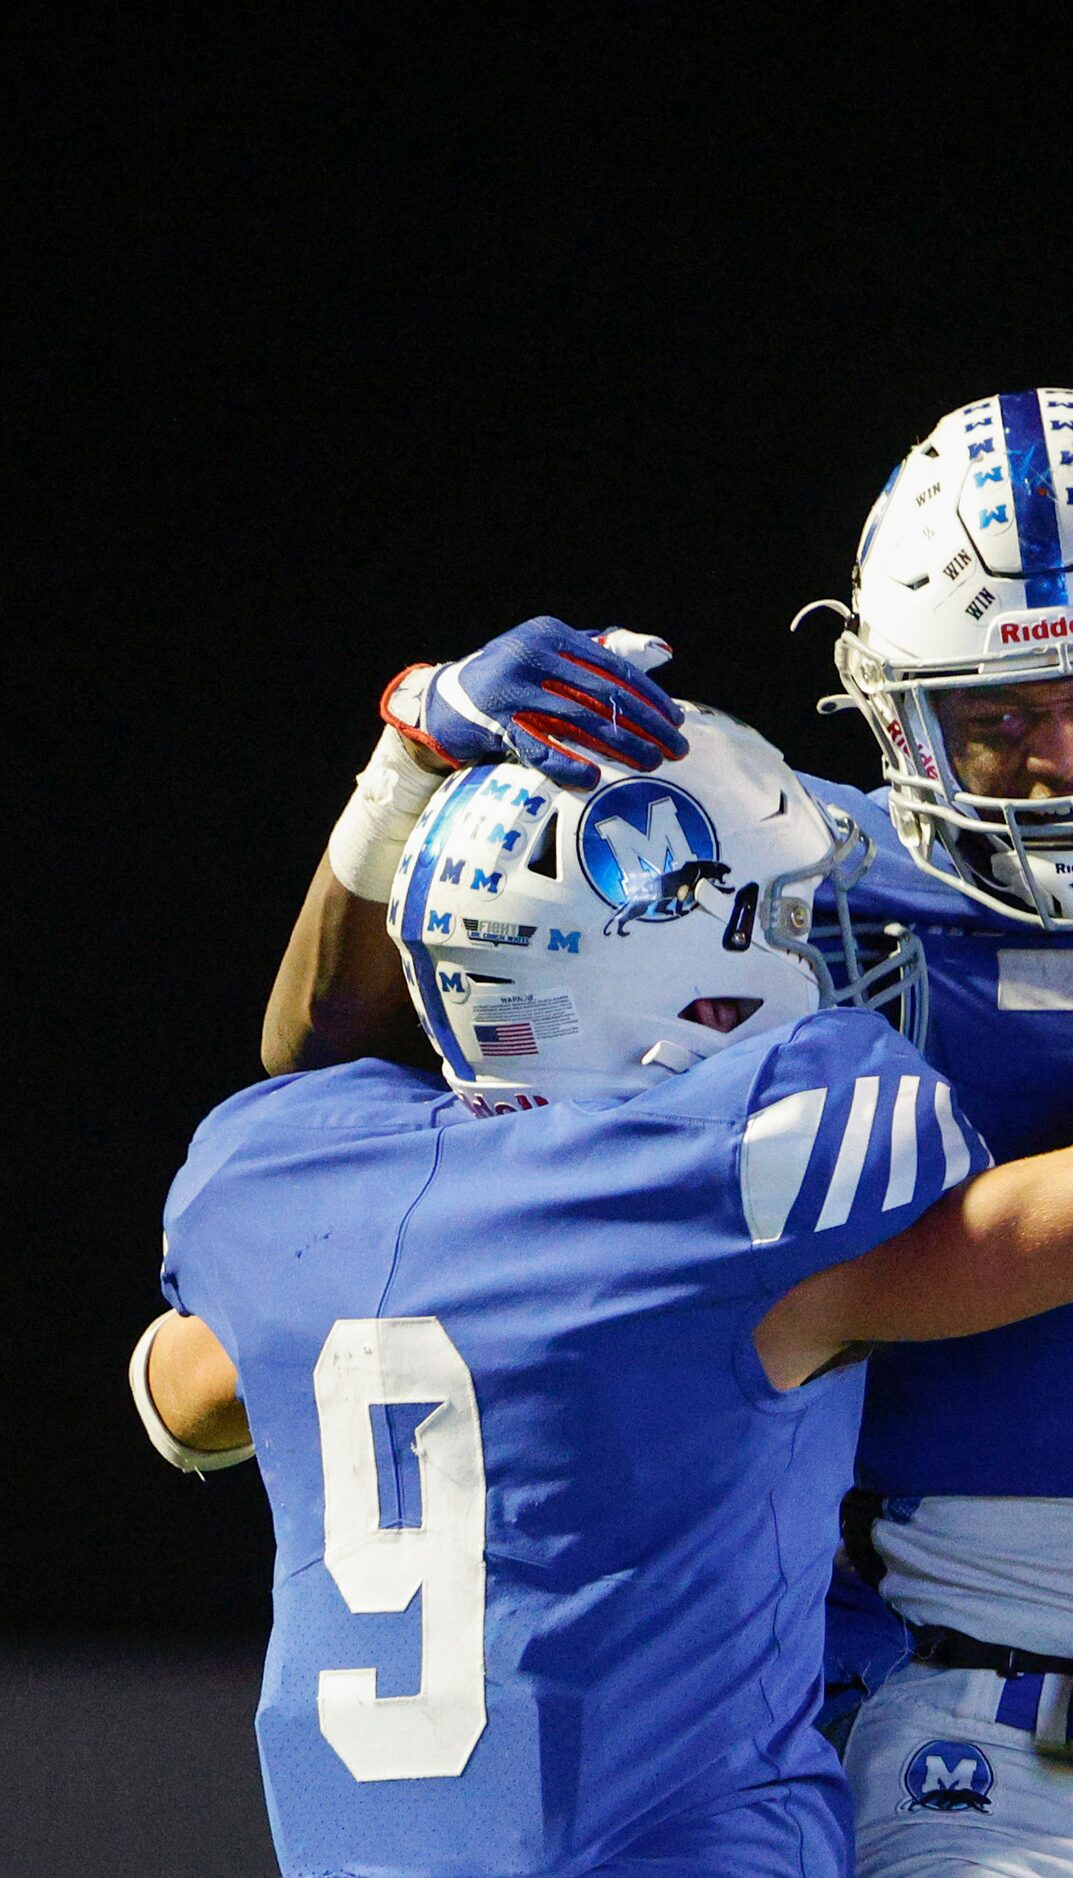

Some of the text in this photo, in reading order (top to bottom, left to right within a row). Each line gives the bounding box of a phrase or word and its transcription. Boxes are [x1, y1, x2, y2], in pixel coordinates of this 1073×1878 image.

[915, 482, 941, 507] WIN
[943, 549, 972, 581] WIN
[965, 587, 996, 620] WIN
[481, 779, 512, 799] M
[512, 788, 546, 817] M
[487, 823, 521, 852] M
[594, 796, 699, 900] M
[440, 857, 466, 884] M
[470, 868, 503, 894] M
[427, 910, 452, 935] M
[548, 929, 581, 953] M
[438, 971, 466, 993] M
[313, 1316, 487, 1783] 9
[922, 1755, 978, 1793] M
